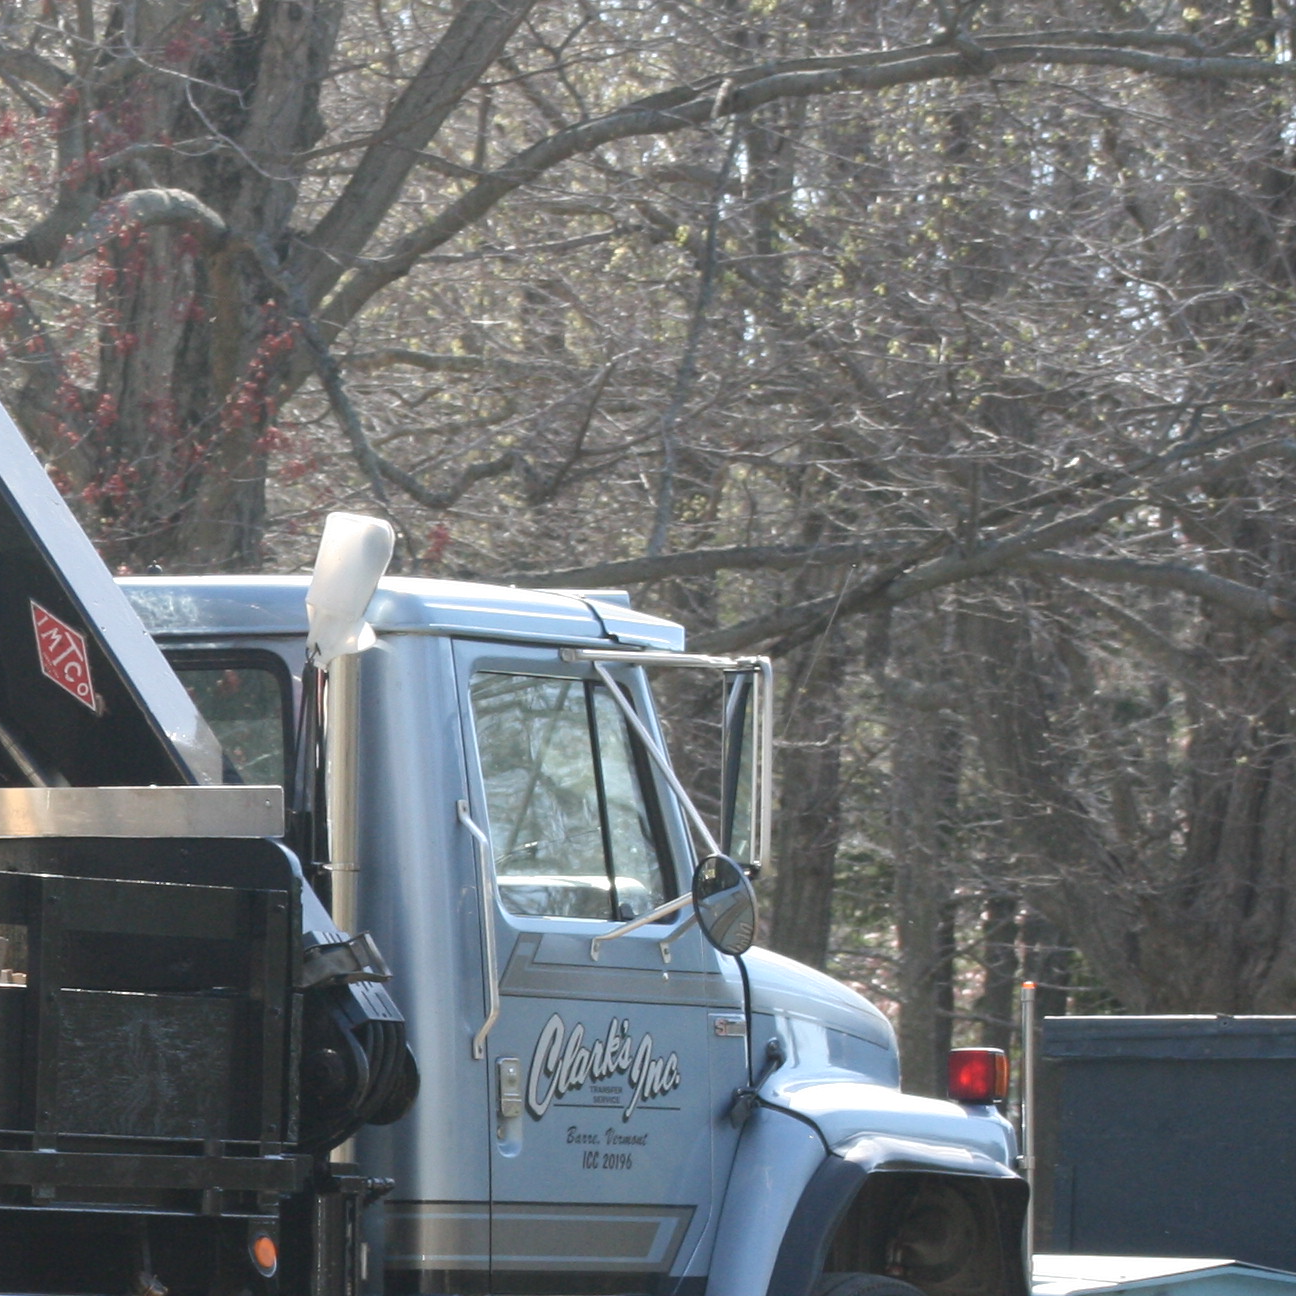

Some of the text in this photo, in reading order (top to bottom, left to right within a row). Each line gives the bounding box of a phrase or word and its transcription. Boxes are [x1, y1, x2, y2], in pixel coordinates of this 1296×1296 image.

[37, 616, 89, 696] IMTCO
[526, 1012, 681, 1121] Clark's Inc.
[582, 1151, 633, 1170] ICC 20196
[605, 1127, 648, 1147] Vermont
